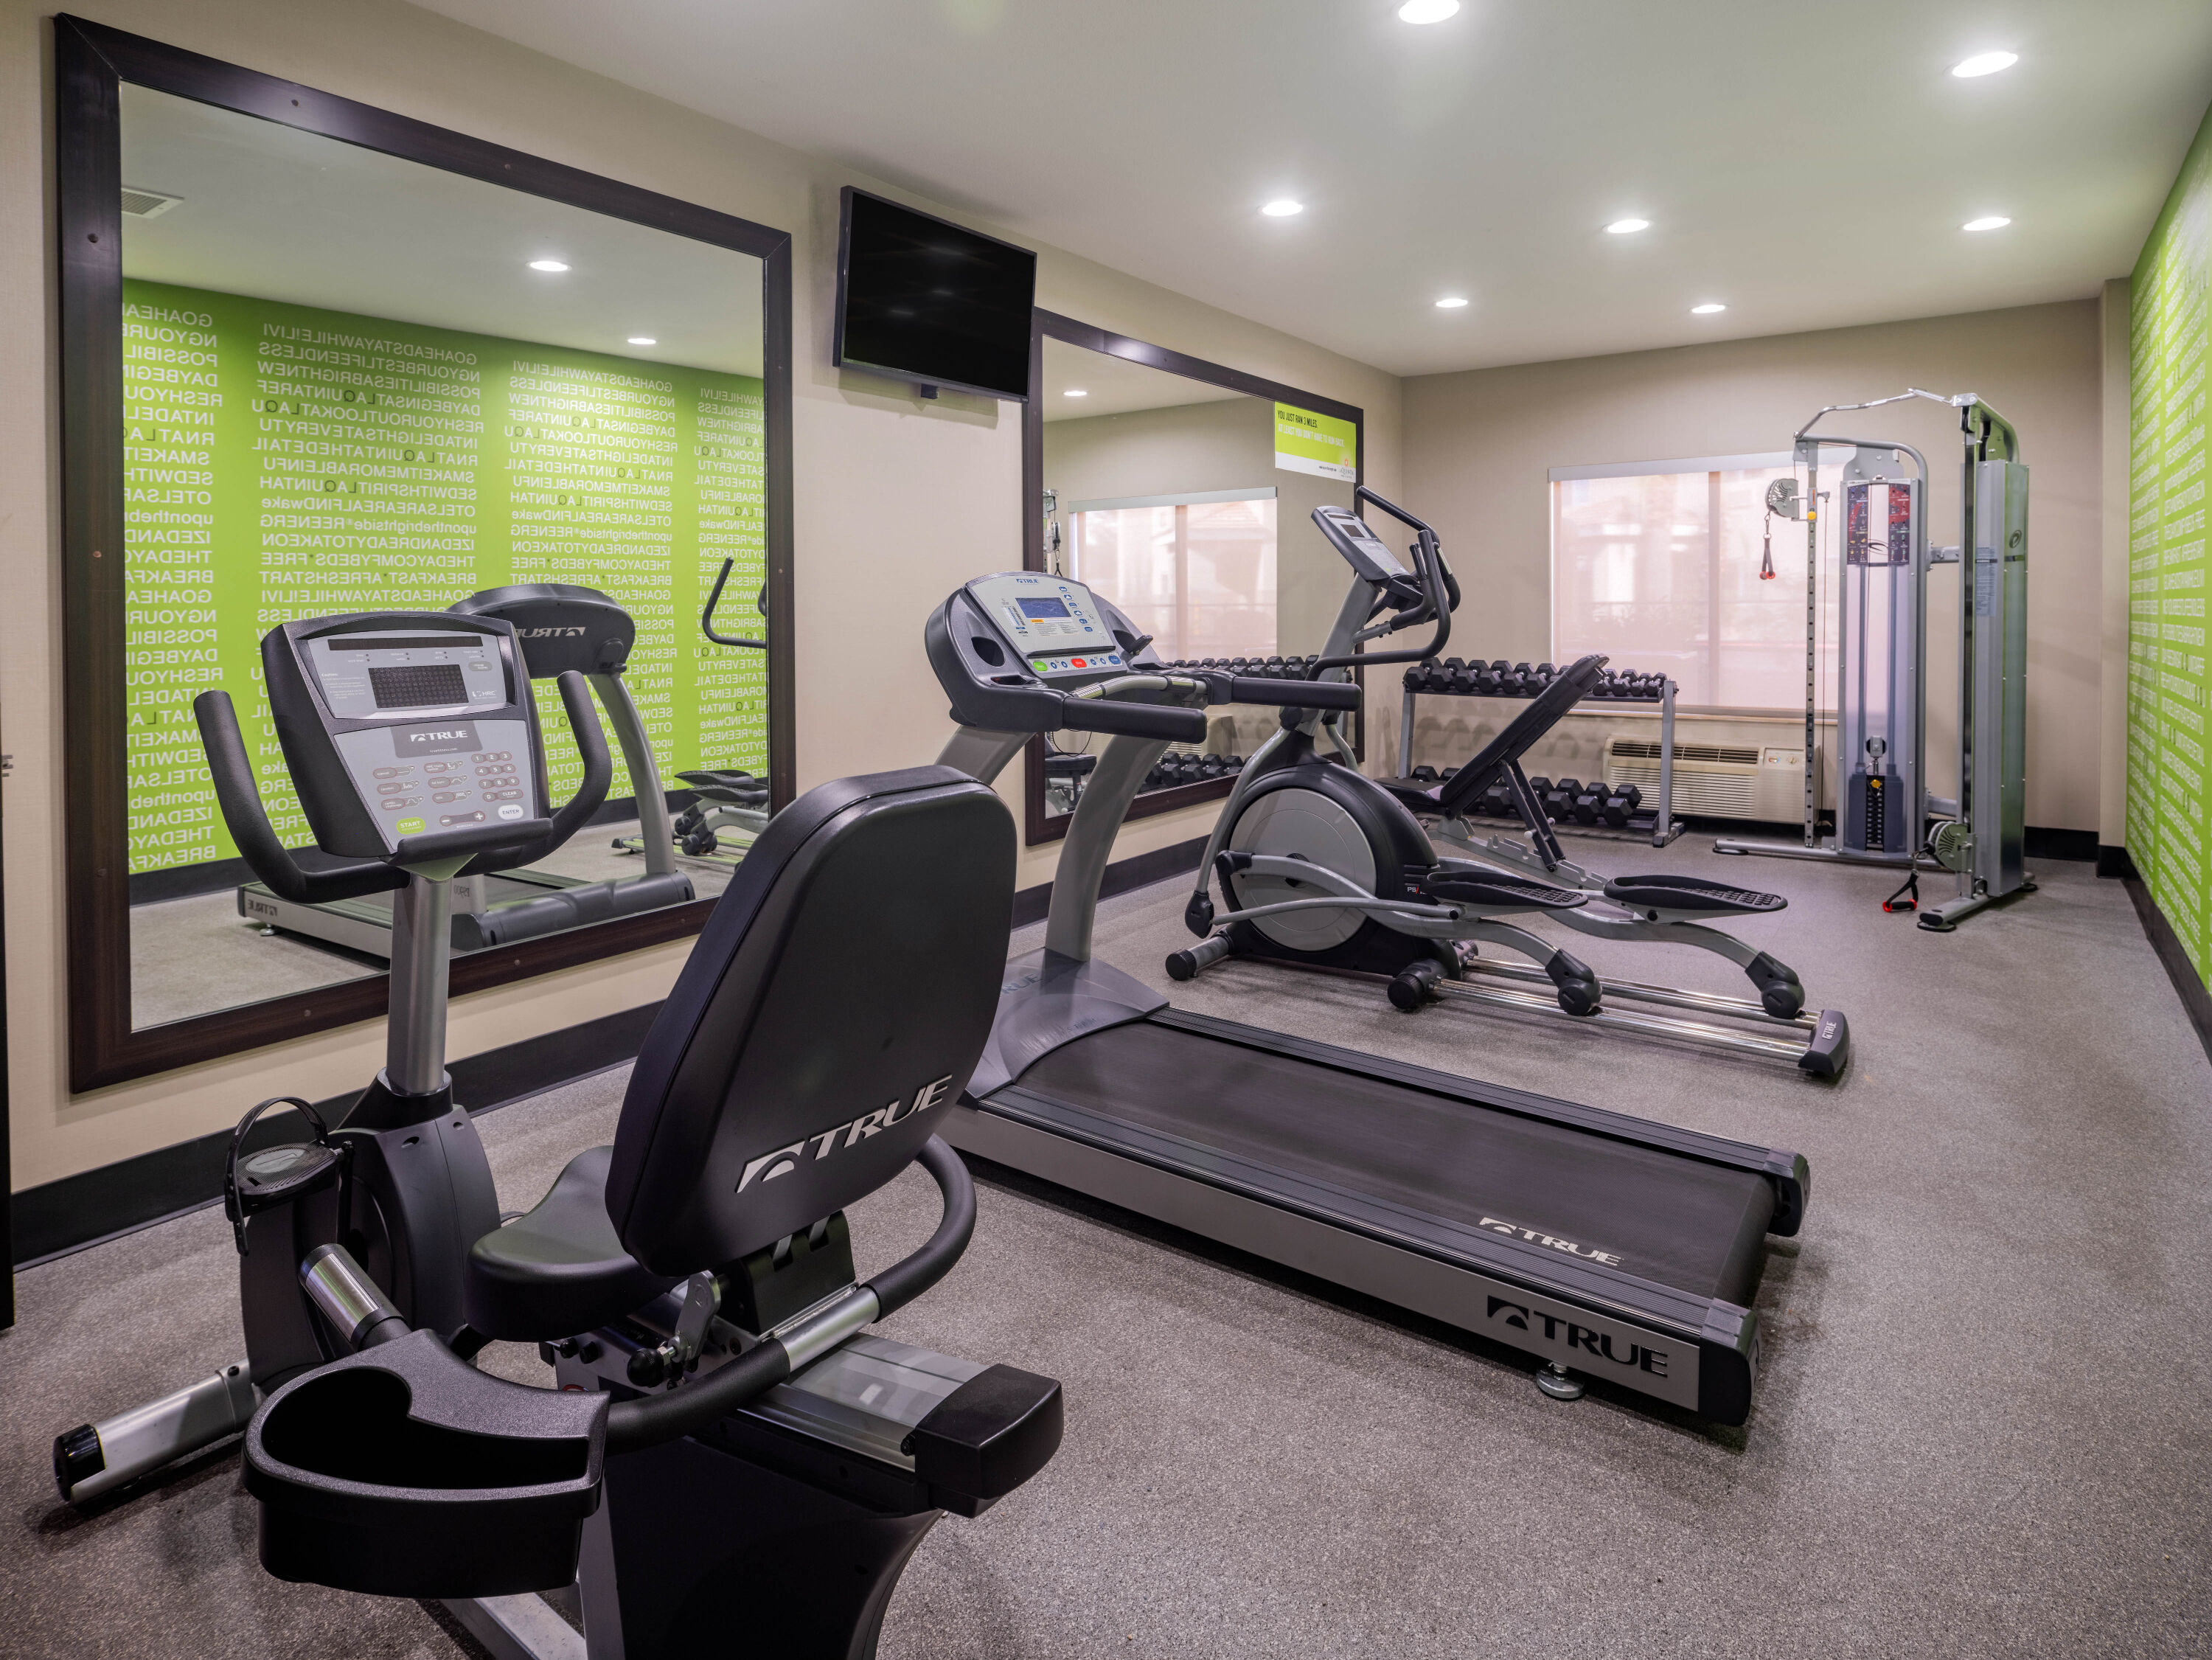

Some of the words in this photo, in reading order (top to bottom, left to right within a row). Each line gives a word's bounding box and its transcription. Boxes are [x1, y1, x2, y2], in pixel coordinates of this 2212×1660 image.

[1277, 410, 1285, 420] YOU
[1286, 411, 1295, 422] JUST
[1295, 414, 1303, 424] RAN
[425, 730, 468, 740] TRUE
[809, 1074, 953, 1161] TRUE
[1517, 1227, 1621, 1267] TRUE
[1533, 1310, 1669, 1378] TRUE
